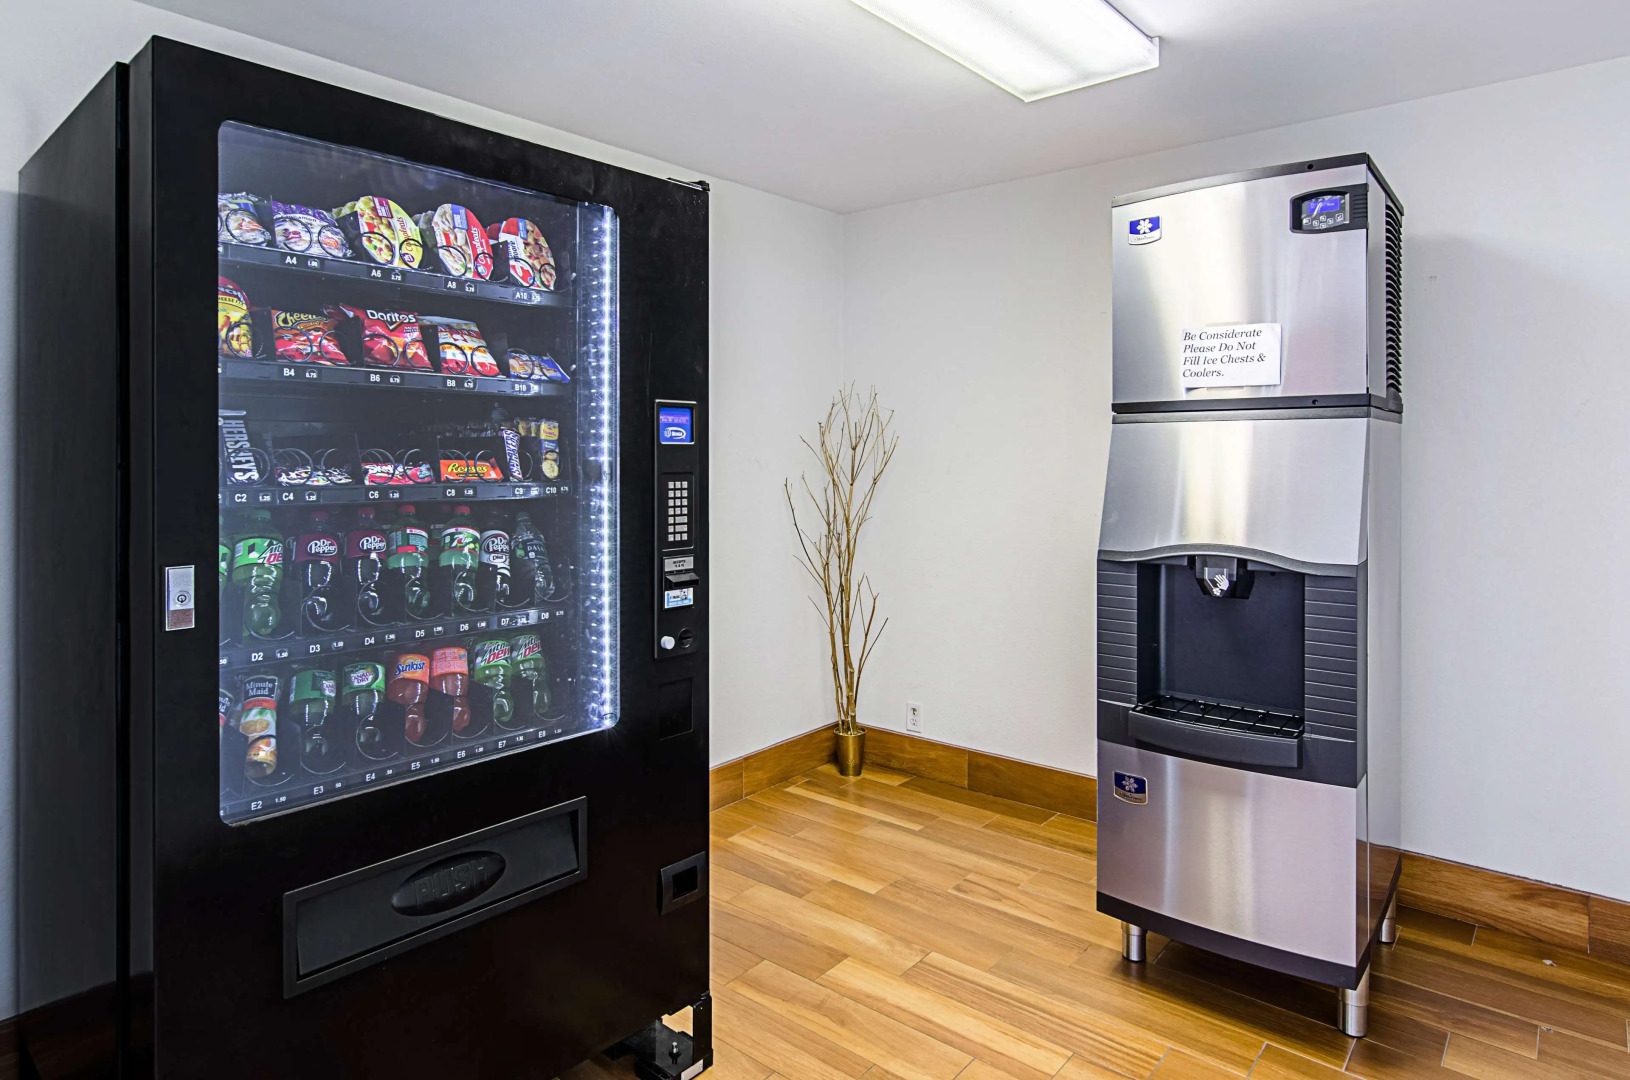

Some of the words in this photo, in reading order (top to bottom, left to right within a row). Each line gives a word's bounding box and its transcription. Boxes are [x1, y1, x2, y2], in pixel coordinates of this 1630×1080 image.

[285, 256, 297, 265] A4
[371, 269, 382, 278] A6
[447, 281, 456, 289] A8
[515, 292, 527, 300] A10
[366, 309, 416, 323] Doritos
[1183, 331, 1196, 341] Be
[1199, 329, 1262, 341] Considerate
[1183, 343, 1216, 353] Please
[1218, 342, 1234, 352] Do
[1236, 341, 1256, 351] Not
[1182, 356, 1200, 365] Fill
[1203, 356, 1218, 365] Ice
[1220, 354, 1255, 364] Chests
[1257, 352, 1266, 362] &
[283, 368, 295, 377] B4
[1182, 368, 1224, 378] Coolers.
[370, 374, 381, 382] B6
[446, 379, 456, 387] B8
[515, 384, 527, 392] B10
[446, 489, 456, 497] C8
[545, 486, 557, 494] C10
[235, 493, 247, 502] C2
[282, 492, 294, 501] C4
[368, 491, 379, 499] C6
[320, 539, 330, 547] Dr
[362, 537, 386, 550] Pepper
[371, 535, 381, 543] Dr
[498, 537, 507, 545] Dr
[311, 540, 337, 554] Pepper
[541, 612, 550, 620] D8
[501, 617, 510, 626] D7
[460, 623, 469, 631] D6
[415, 629, 425, 638] D5
[364, 636, 375, 645] D4
[309, 644, 321, 653] D3
[251, 652, 264, 661] D2
[394, 660, 426, 676] Sunkist
[356, 676, 369, 684] DRY
[245, 681, 273, 690] Minute
[248, 687, 269, 696] Maid
[538, 730, 546, 738] E8
[498, 740, 507, 748] E7
[457, 750, 466, 759] E6
[411, 761, 421, 770] E5
[365, 772, 376, 781] E4
[313, 786, 324, 795] E3
[251, 801, 263, 810] E2
[413, 857, 488, 906] PUSH
